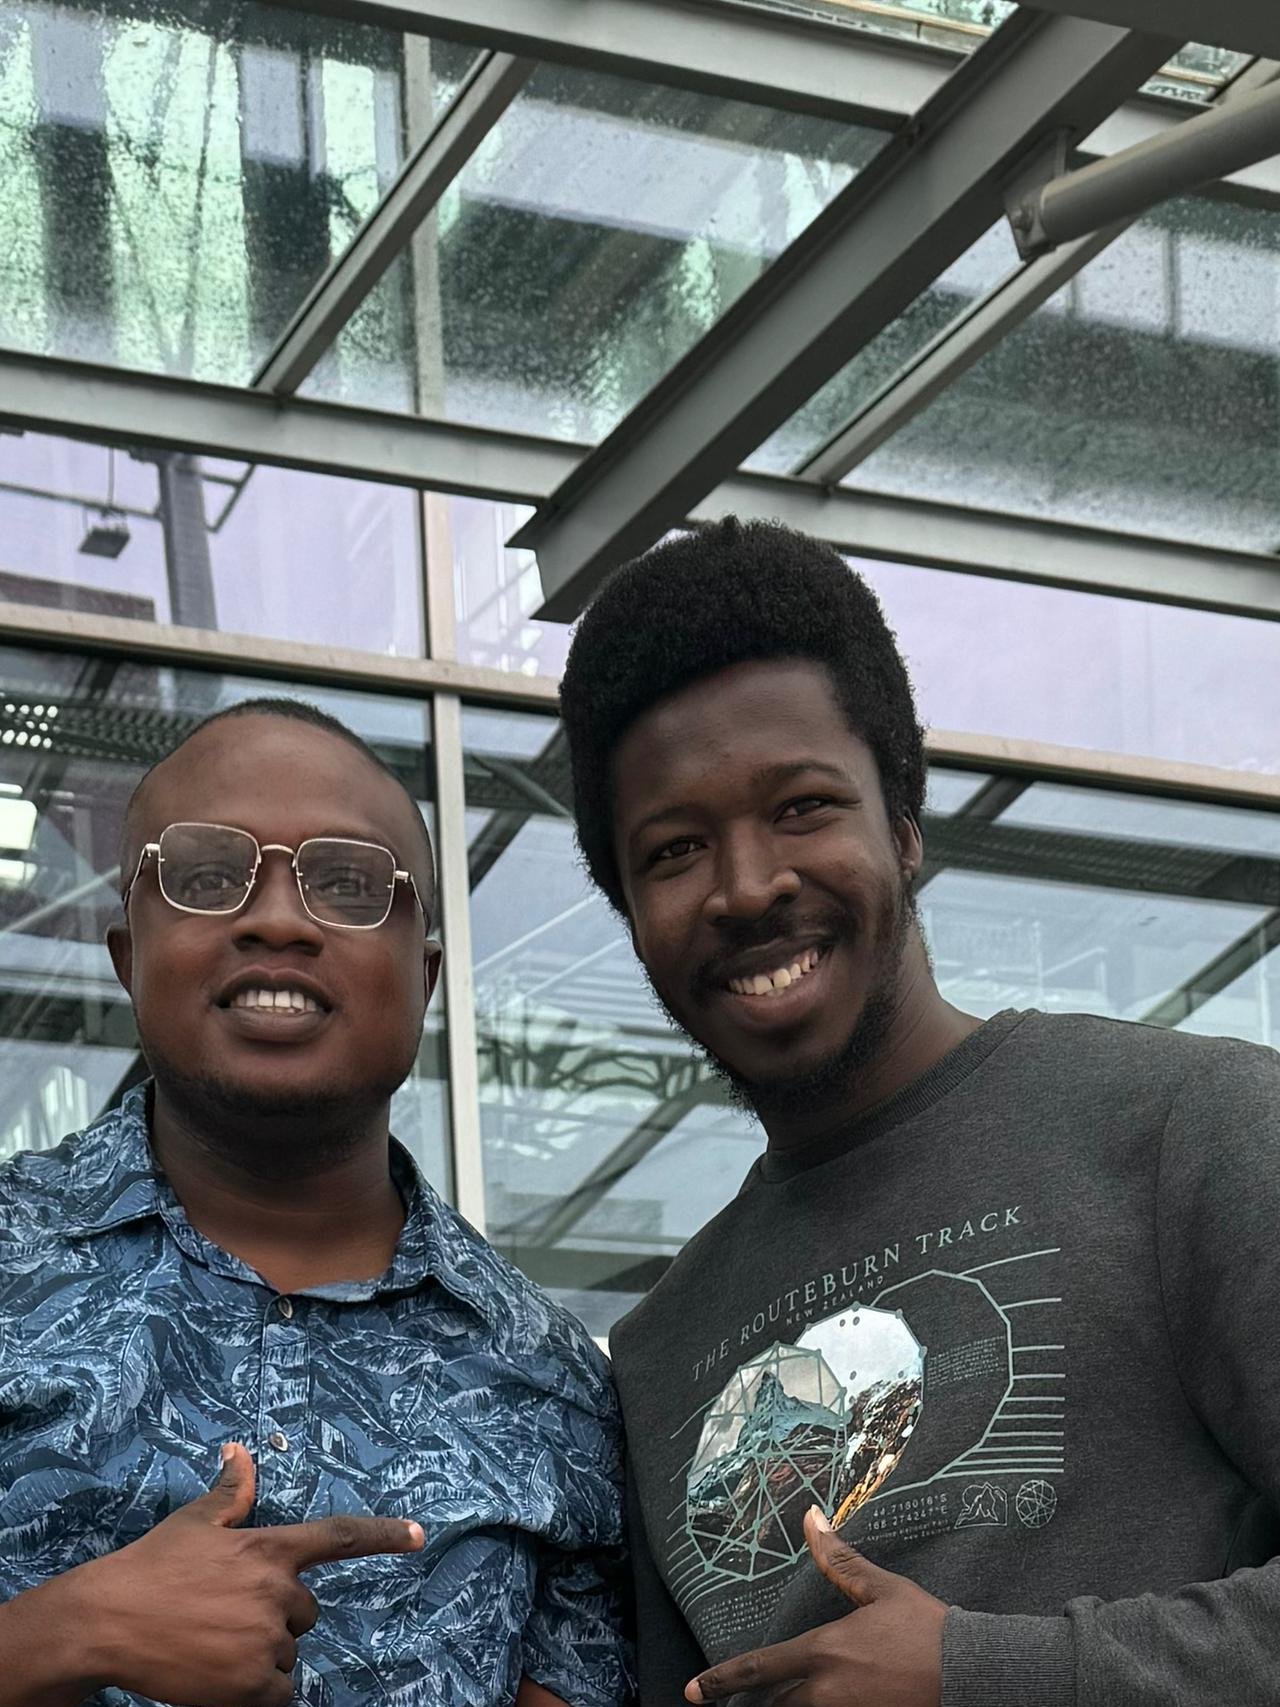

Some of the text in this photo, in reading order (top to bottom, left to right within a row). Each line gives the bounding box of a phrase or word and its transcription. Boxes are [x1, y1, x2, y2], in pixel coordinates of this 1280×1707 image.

[692, 1205, 1022, 1382] THE ROUTEBURN TRACK
[786, 1275, 885, 1326] NEW ZEALAND
